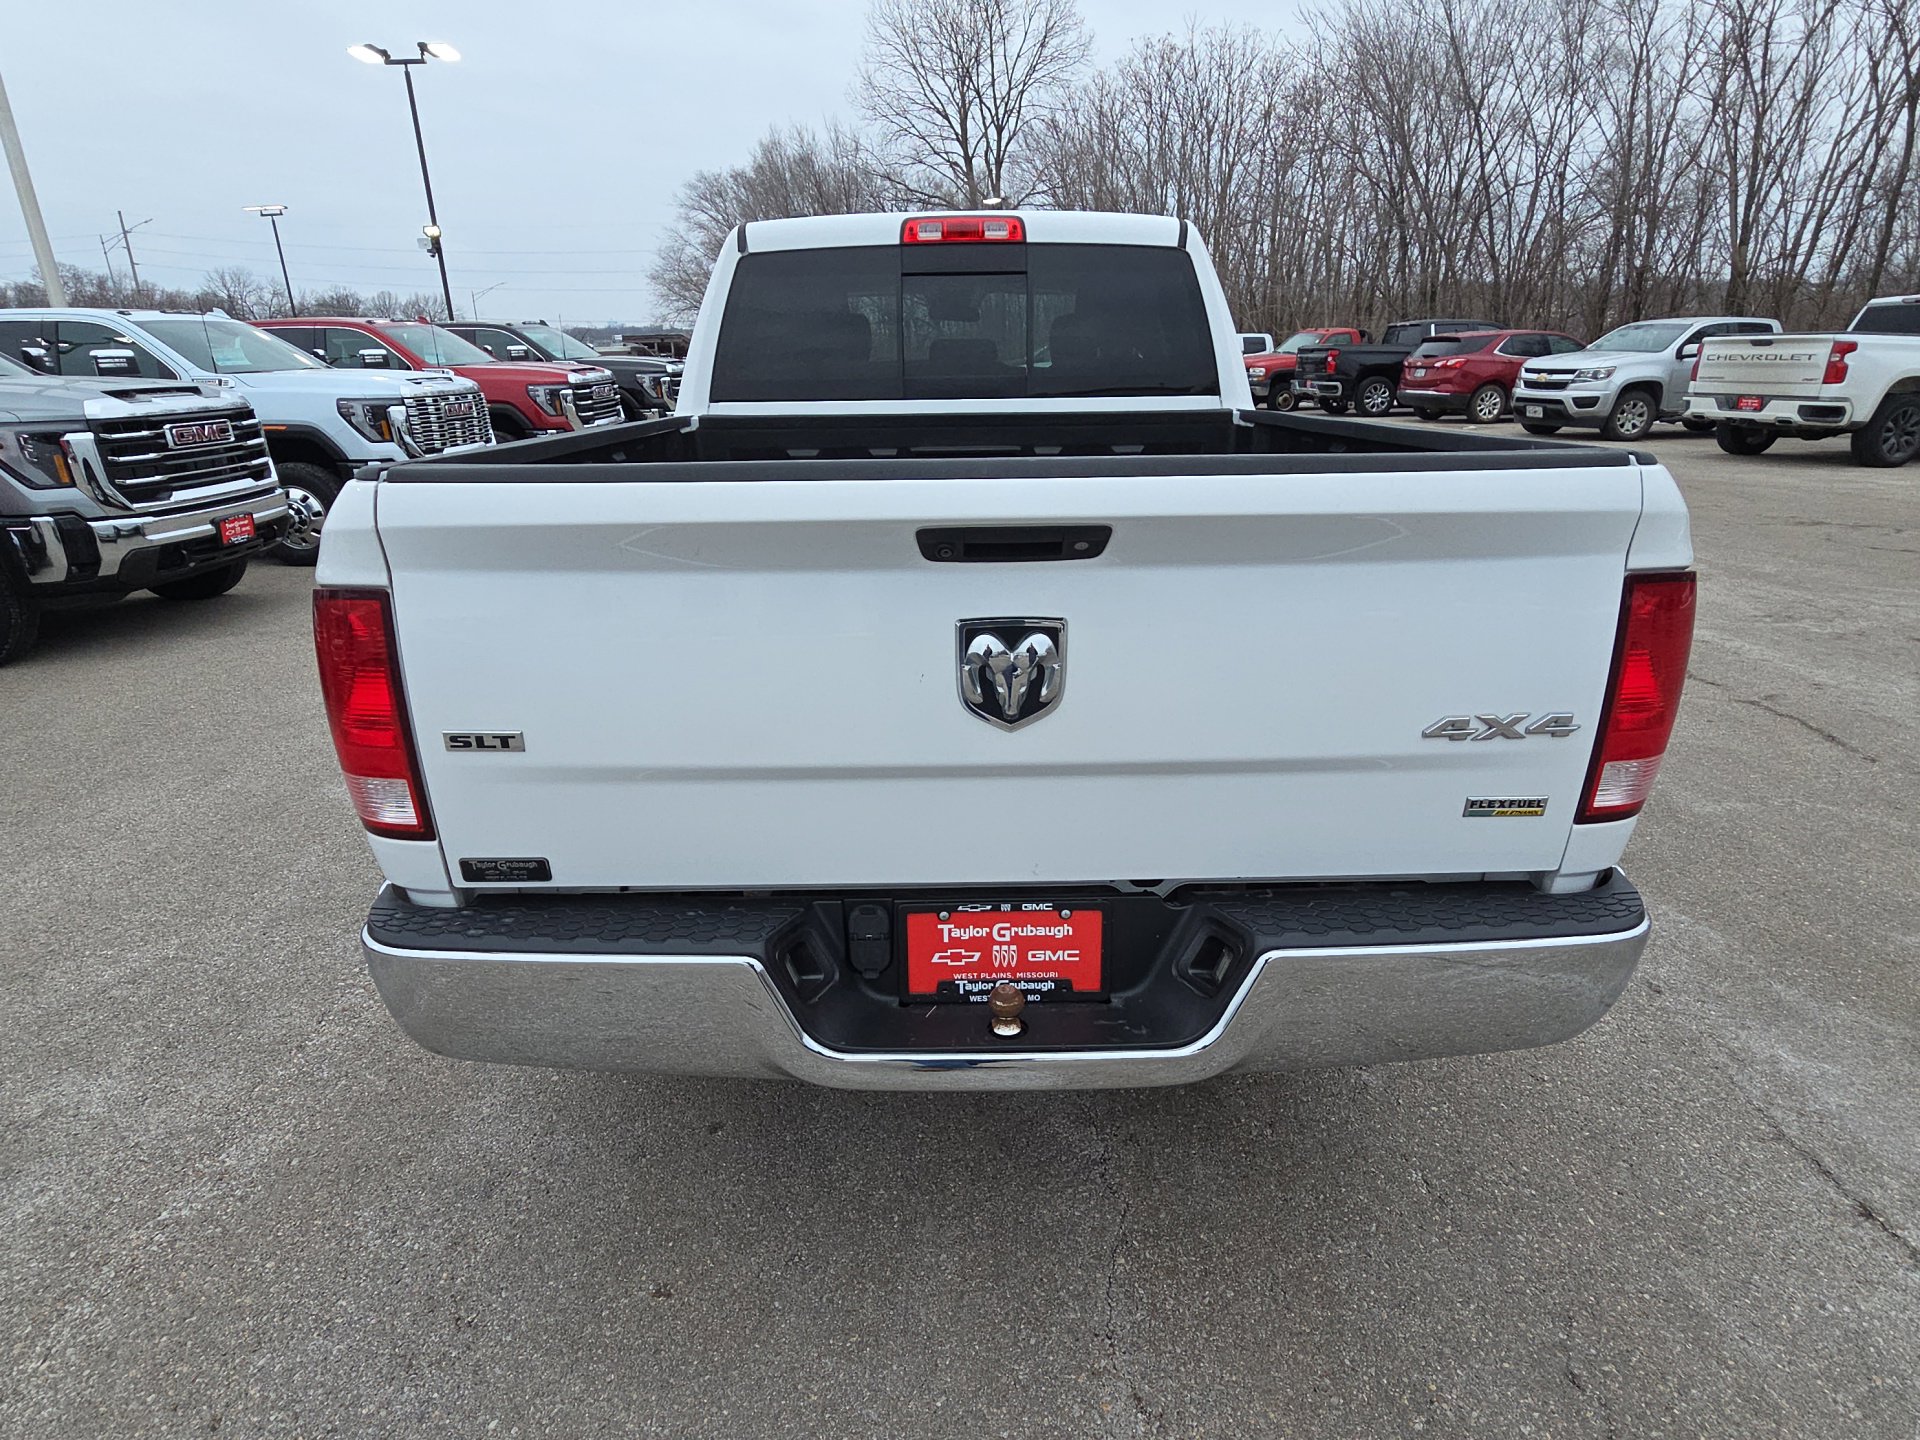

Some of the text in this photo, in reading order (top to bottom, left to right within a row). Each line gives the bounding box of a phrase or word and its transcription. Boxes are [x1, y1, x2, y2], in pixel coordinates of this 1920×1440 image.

[1706, 353, 1817, 361] CHEVROLET
[173, 424, 231, 444] GMC
[1422, 712, 1581, 741] 4X4
[449, 735, 516, 749] SLT
[1469, 799, 1545, 808] FLEXFUEL
[468, 860, 538, 870] Taylor Grubaugh
[1022, 903, 1053, 911] GMC
[937, 923, 1073, 943] Taylor Grubaugh
[1028, 950, 1080, 962] GMC
[980, 972, 1015, 980] PLAINS,
[1016, 971, 1059, 979] MISSOURI
[955, 980, 994, 994] Taylor
[1027, 994, 1041, 1002] MO
